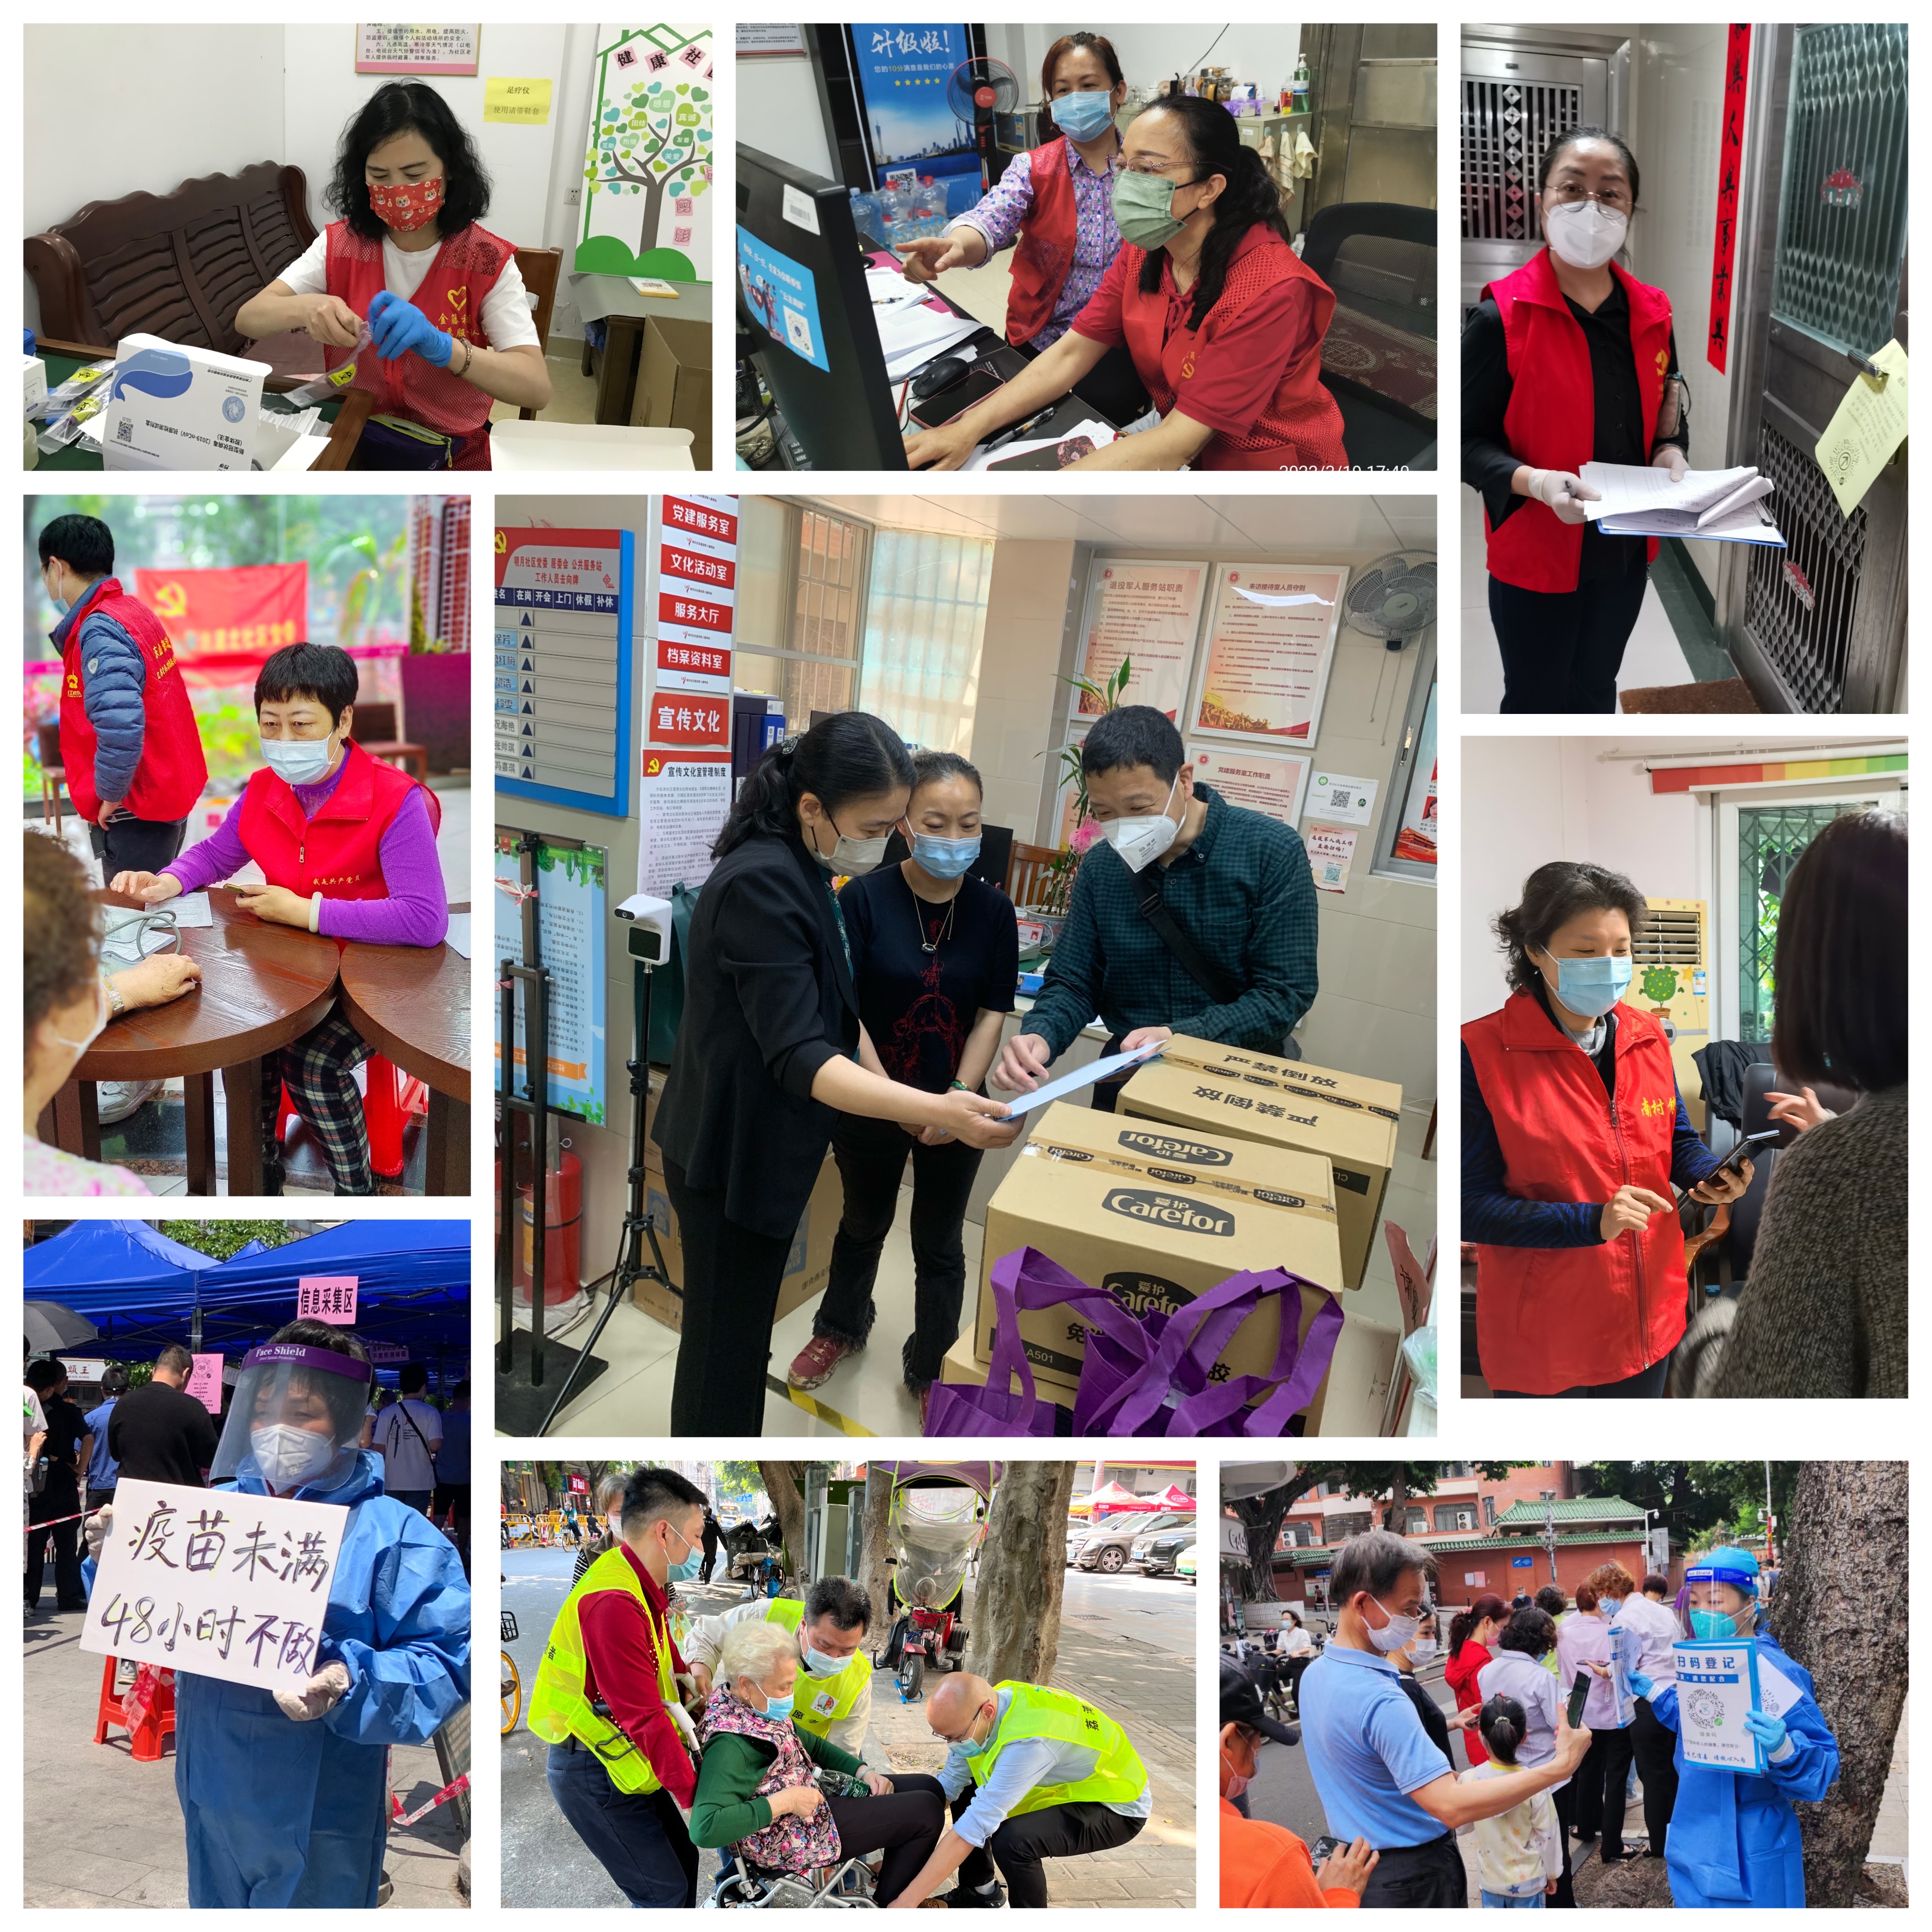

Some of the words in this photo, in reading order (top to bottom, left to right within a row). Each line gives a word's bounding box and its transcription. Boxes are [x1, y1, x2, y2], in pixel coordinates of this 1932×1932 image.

[506, 85, 530, 95] 足疗仪
[493, 105, 540, 116] 使用请带鞋套
[653, 100, 671, 108] 感恩
[678, 114, 697, 122] 真诚
[673, 504, 729, 535] 党建服务室
[514, 556, 548, 568] 明月社区党委
[551, 558, 568, 569] 居委会
[572, 559, 602, 571] 公共服务站
[670, 553, 727, 581] 文化活动室
[535, 573, 579, 585] 工作人员去向牌
[1109, 581, 1184, 592] 退役军人服务站职责
[1249, 583, 1306, 592] 来访接待室人员守则
[517, 589, 531, 601] 在岗
[535, 591, 551, 603] 开会
[556, 593, 571, 605] 上门
[576, 595, 592, 606] 休假
[597, 596, 613, 608] 补休
[675, 602, 719, 623] 服务大厅
[667, 647, 722, 669] 档案资料室
[657, 707, 720, 732] 宣传文化
[668, 767, 726, 777] 宣传文化室管理制度
[1218, 767, 1271, 780] 党建服务室工作职责
[313, 874, 360, 886] 我是共产党员
[1223, 1055, 1338, 1089] 严禁倒放
[1192, 1086, 1319, 1127] 严禁倒放
[1125, 1134, 1225, 1162] Carefor
[1157, 1150, 1188, 1160] 爱护
[1150, 1168, 1194, 1184] Carefor
[1154, 1197, 1189, 1209] 爱护
[1111, 1194, 1228, 1233] Carefor
[1138, 1280, 1165, 1295] 爱护
[300, 1288, 353, 1315] 信息采集区
[255, 1347, 273, 1358] Face
[274, 1346, 305, 1357] Shield
[128, 1500, 330, 1592] 疫苗未满
[101, 1594, 316, 1677] 48小时不做
[1677, 1656, 1736, 1669] 扫码登记
